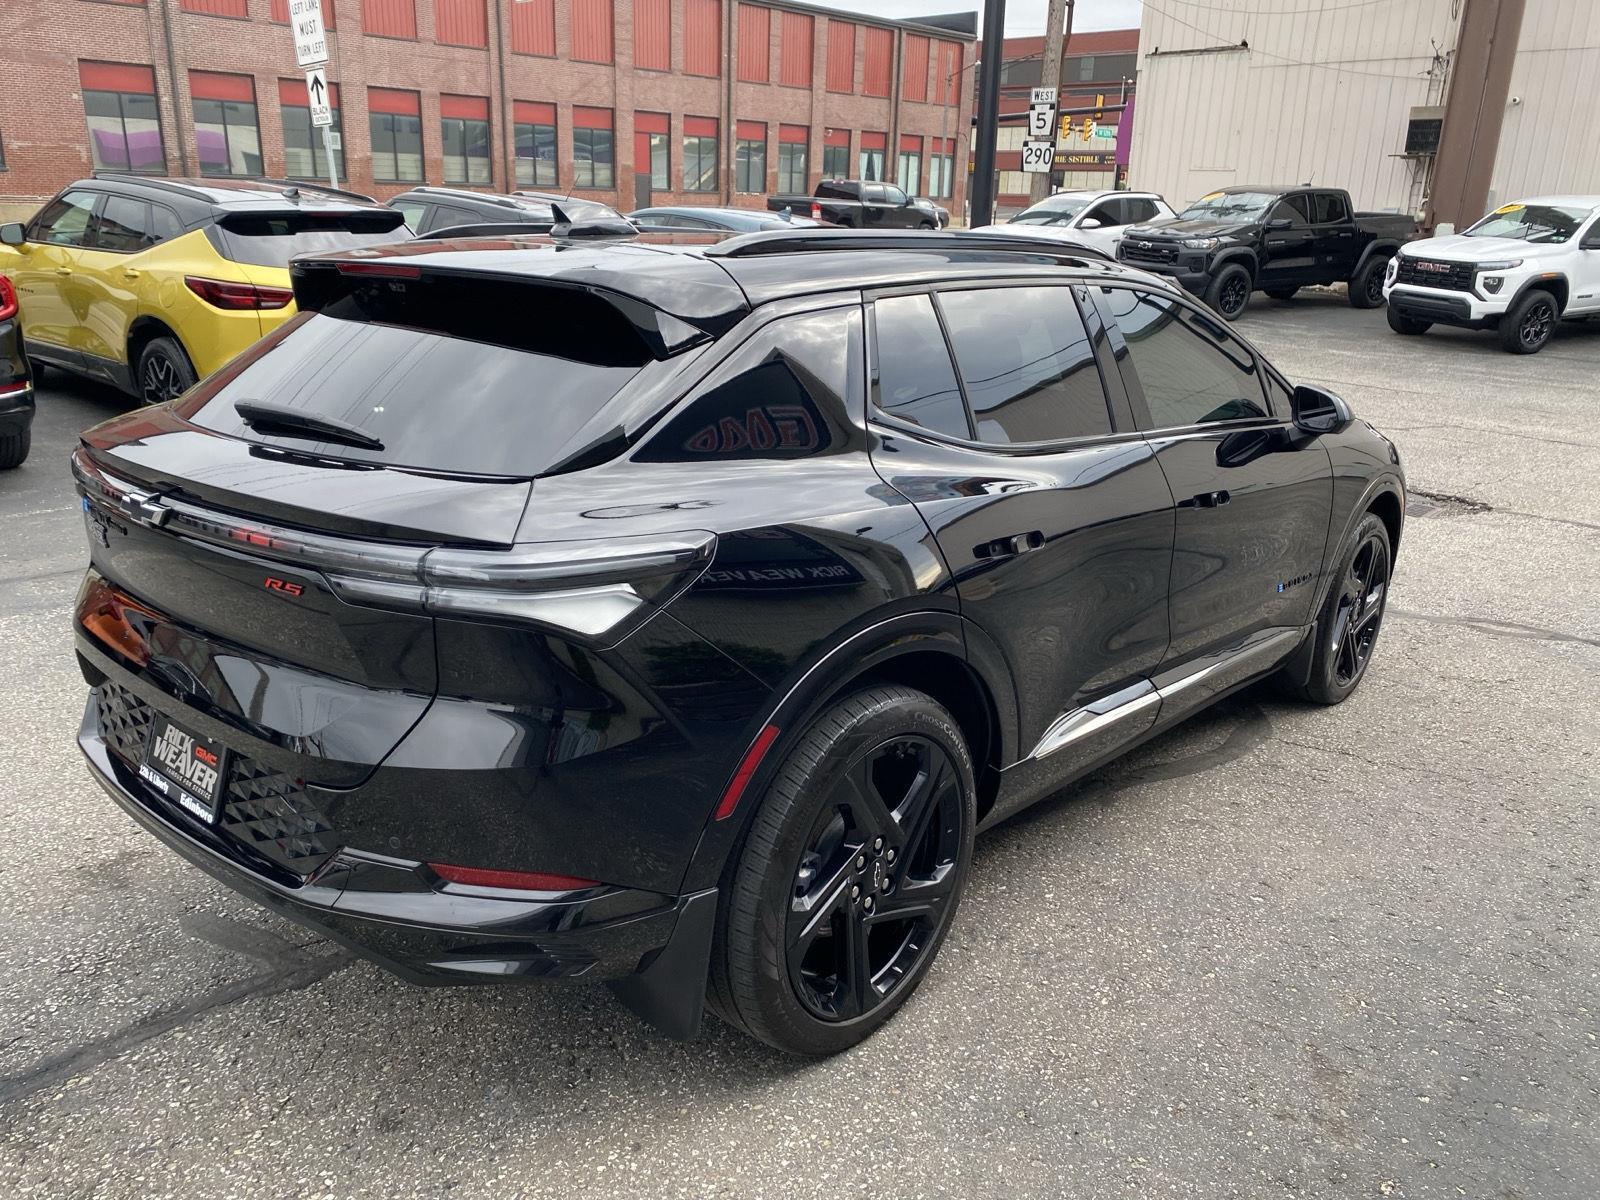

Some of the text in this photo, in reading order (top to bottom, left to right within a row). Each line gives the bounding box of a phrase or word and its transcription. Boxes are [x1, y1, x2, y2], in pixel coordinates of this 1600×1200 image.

[291, 0, 319, 16] LEFT LANE
[299, 19, 317, 36] MUST
[297, 41, 326, 57] TURN LEFT
[1034, 90, 1054, 101] WEST
[312, 105, 328, 116] BLACK
[1035, 112, 1047, 130] 5
[1024, 147, 1052, 165] 290
[1416, 261, 1451, 273] GMC
[264, 577, 303, 596] RS
[163, 723, 195, 753] RICK
[153, 736, 218, 793] WEAVER
[194, 745, 218, 766] GMC
[179, 793, 214, 824] Edinboro
